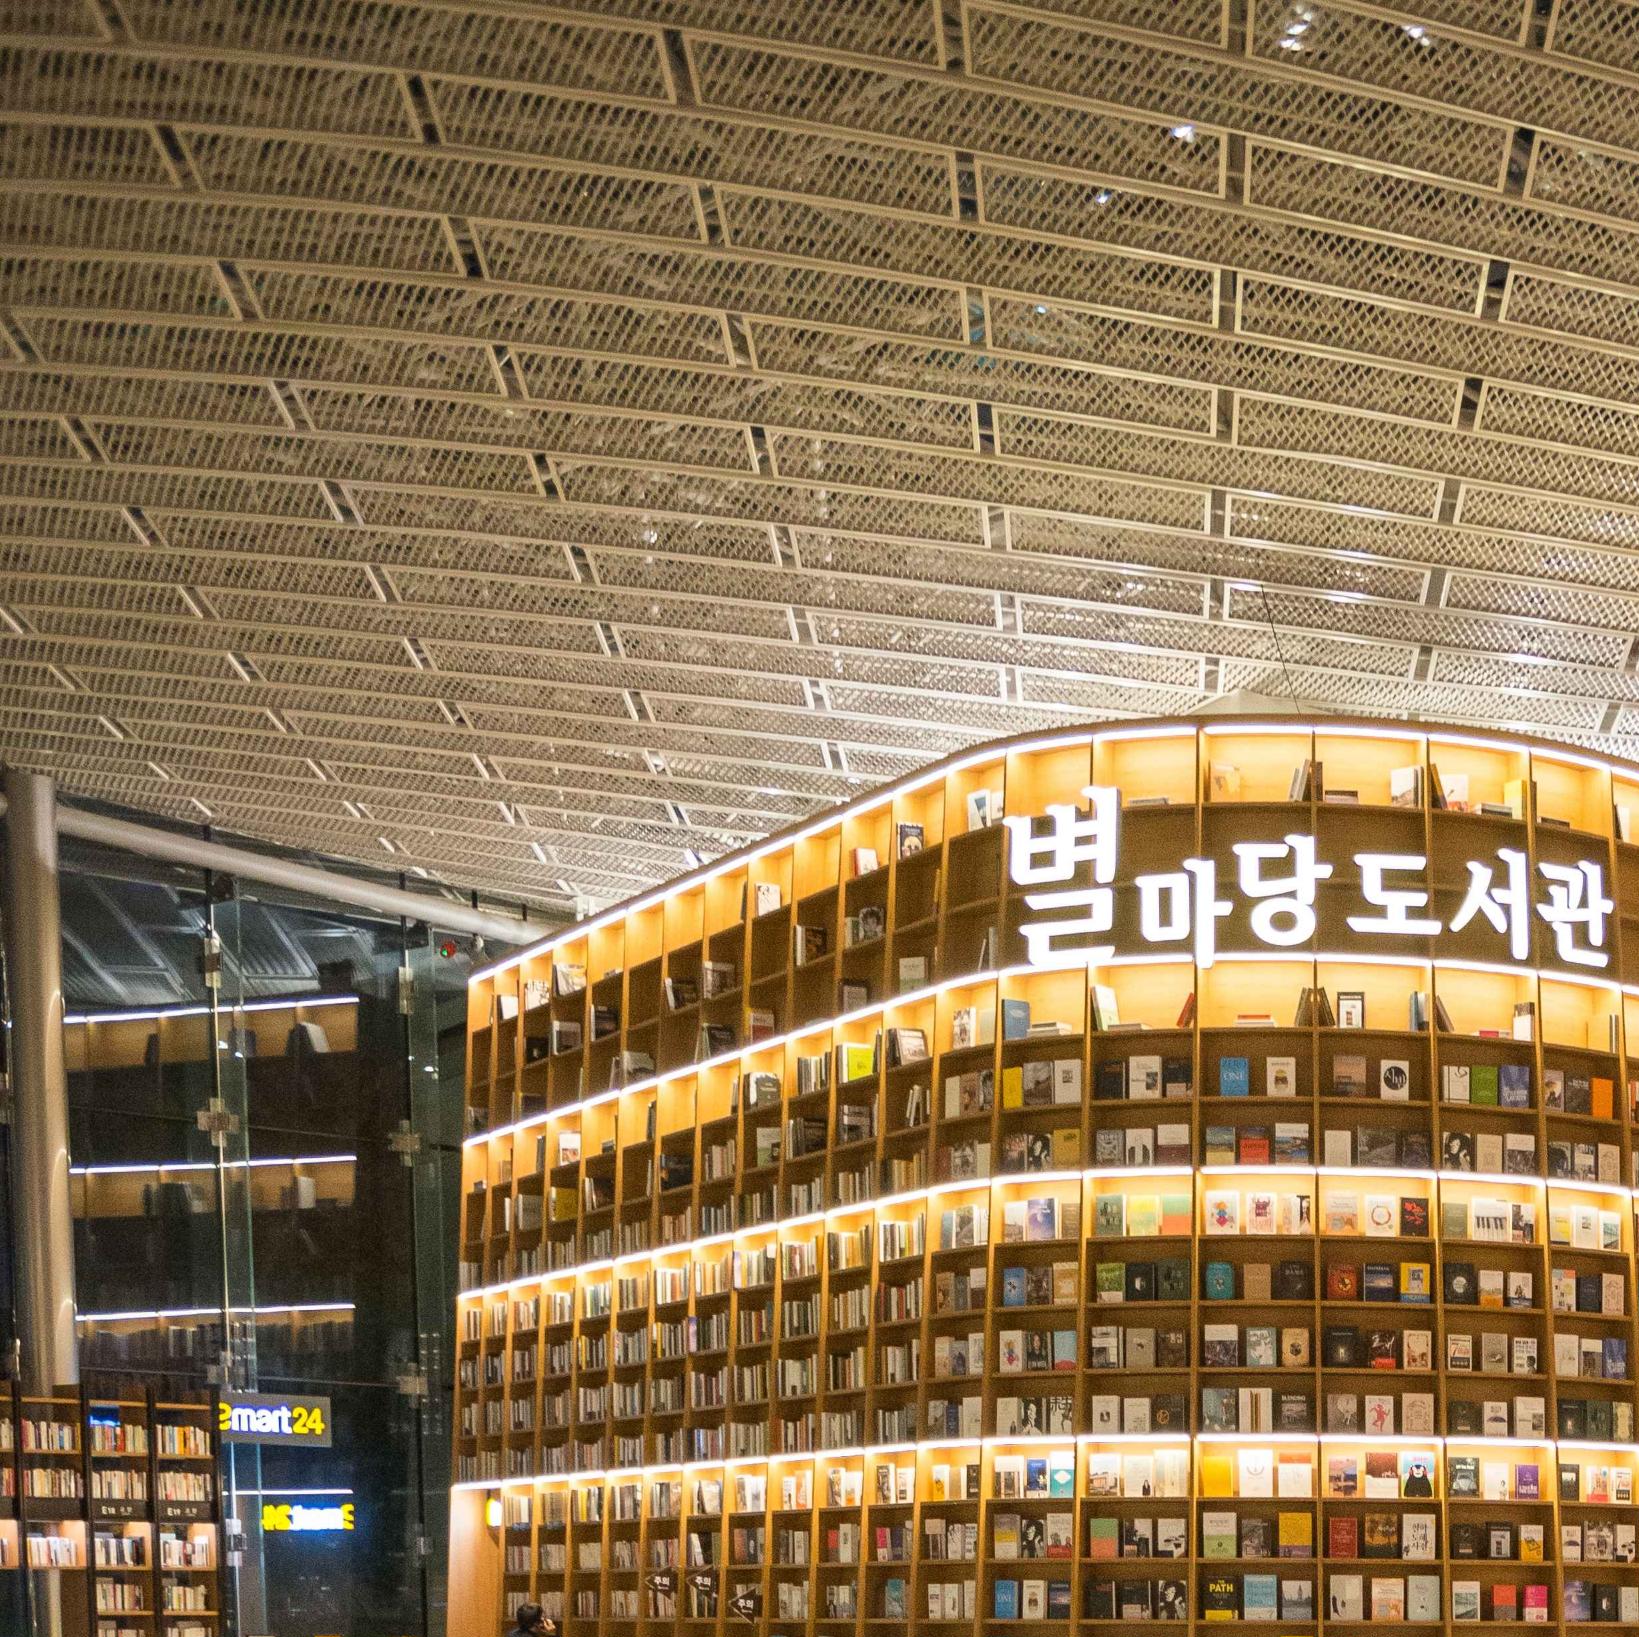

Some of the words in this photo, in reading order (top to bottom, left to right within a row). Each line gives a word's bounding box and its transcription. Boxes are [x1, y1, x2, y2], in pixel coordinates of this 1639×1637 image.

[1002, 786, 1333, 969] 별마당
[1347, 848, 1615, 968] 도서관
[654, 1576, 670, 1586] 주의
[695, 1576, 711, 1586] 주의
[1209, 1583, 1233, 1593] PATH
[737, 1599, 754, 1609] 주의
